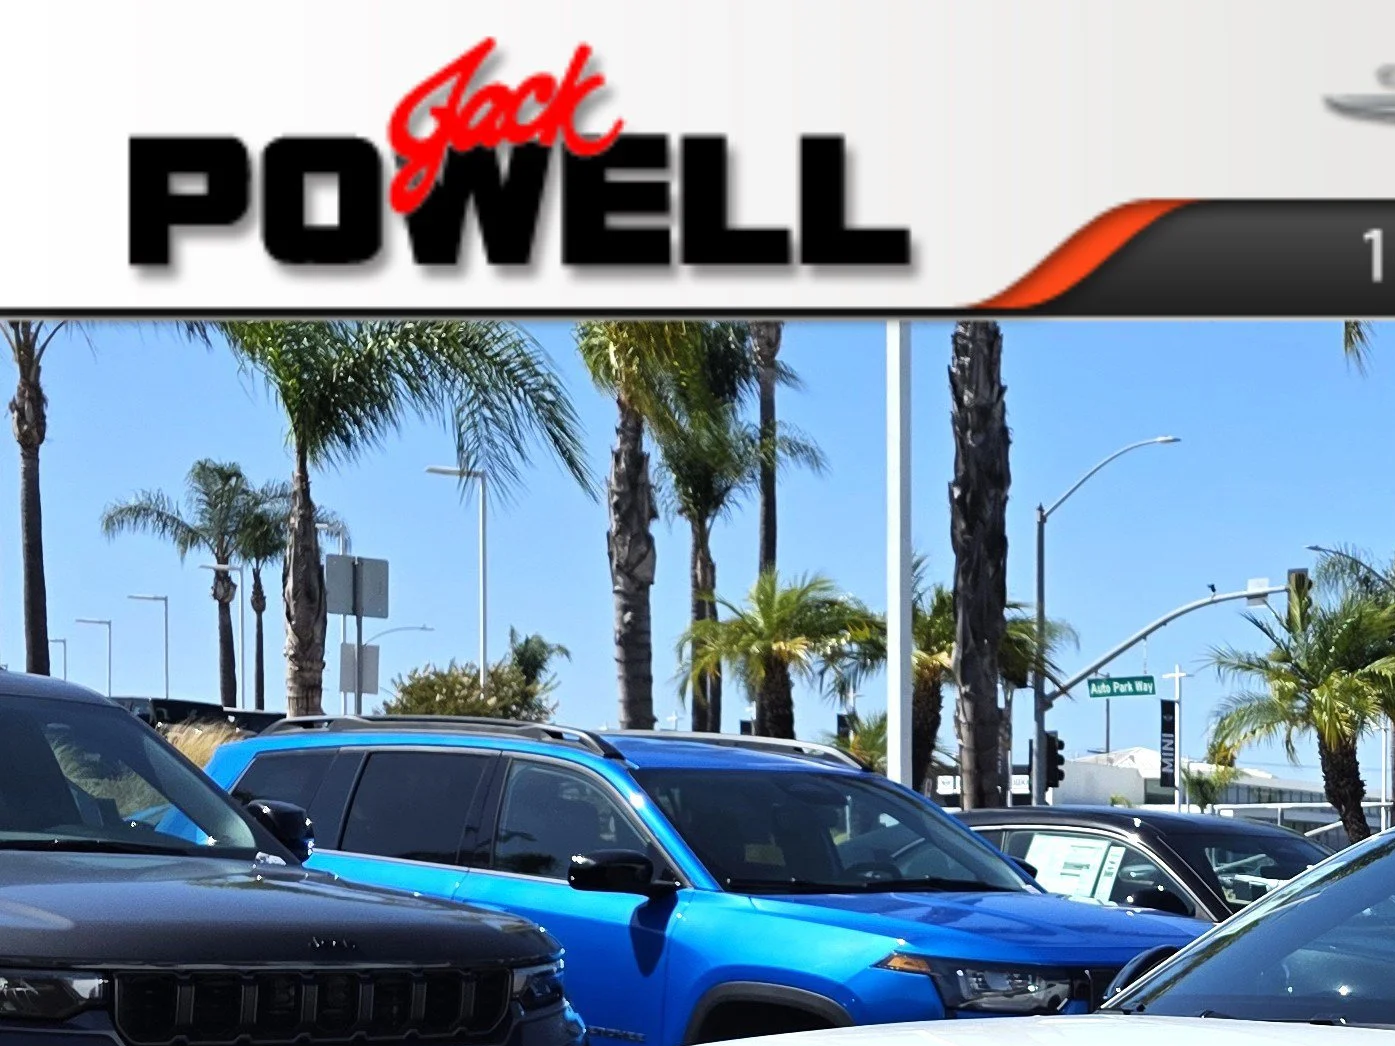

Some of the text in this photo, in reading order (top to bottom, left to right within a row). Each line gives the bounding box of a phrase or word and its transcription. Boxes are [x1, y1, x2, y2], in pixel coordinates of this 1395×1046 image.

[1091, 680, 1154, 694] Auto Park Way
[1162, 733, 1174, 773] MINI
